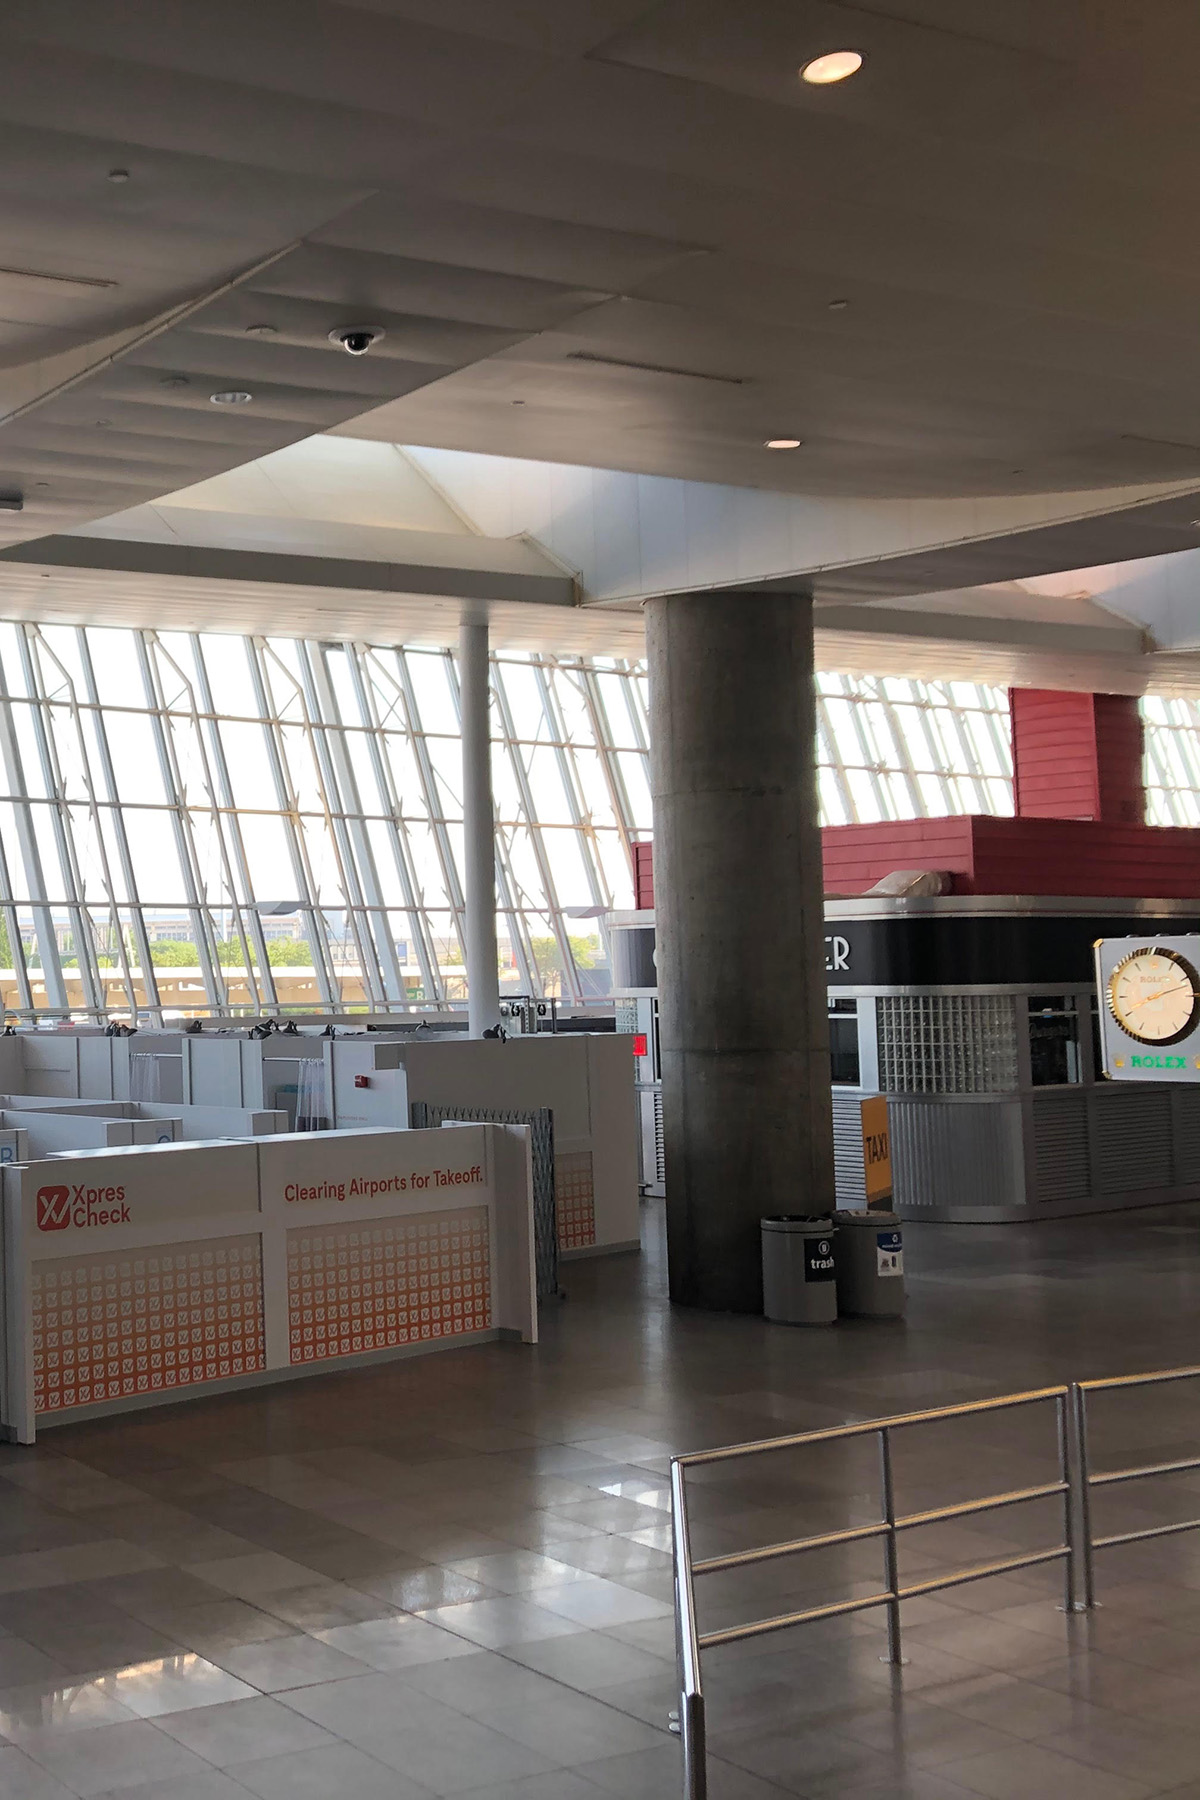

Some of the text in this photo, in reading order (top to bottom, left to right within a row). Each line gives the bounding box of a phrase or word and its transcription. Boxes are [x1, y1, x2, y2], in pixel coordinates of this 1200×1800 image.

[1131, 1055, 1187, 1069] ROLEX
[866, 1133, 888, 1164] TAXI
[72, 1184, 125, 1205] Xpres
[284, 1166, 483, 1202] Clearing Airports for Takeoff.
[73, 1203, 131, 1228] Check
[810, 1256, 835, 1269] trash
